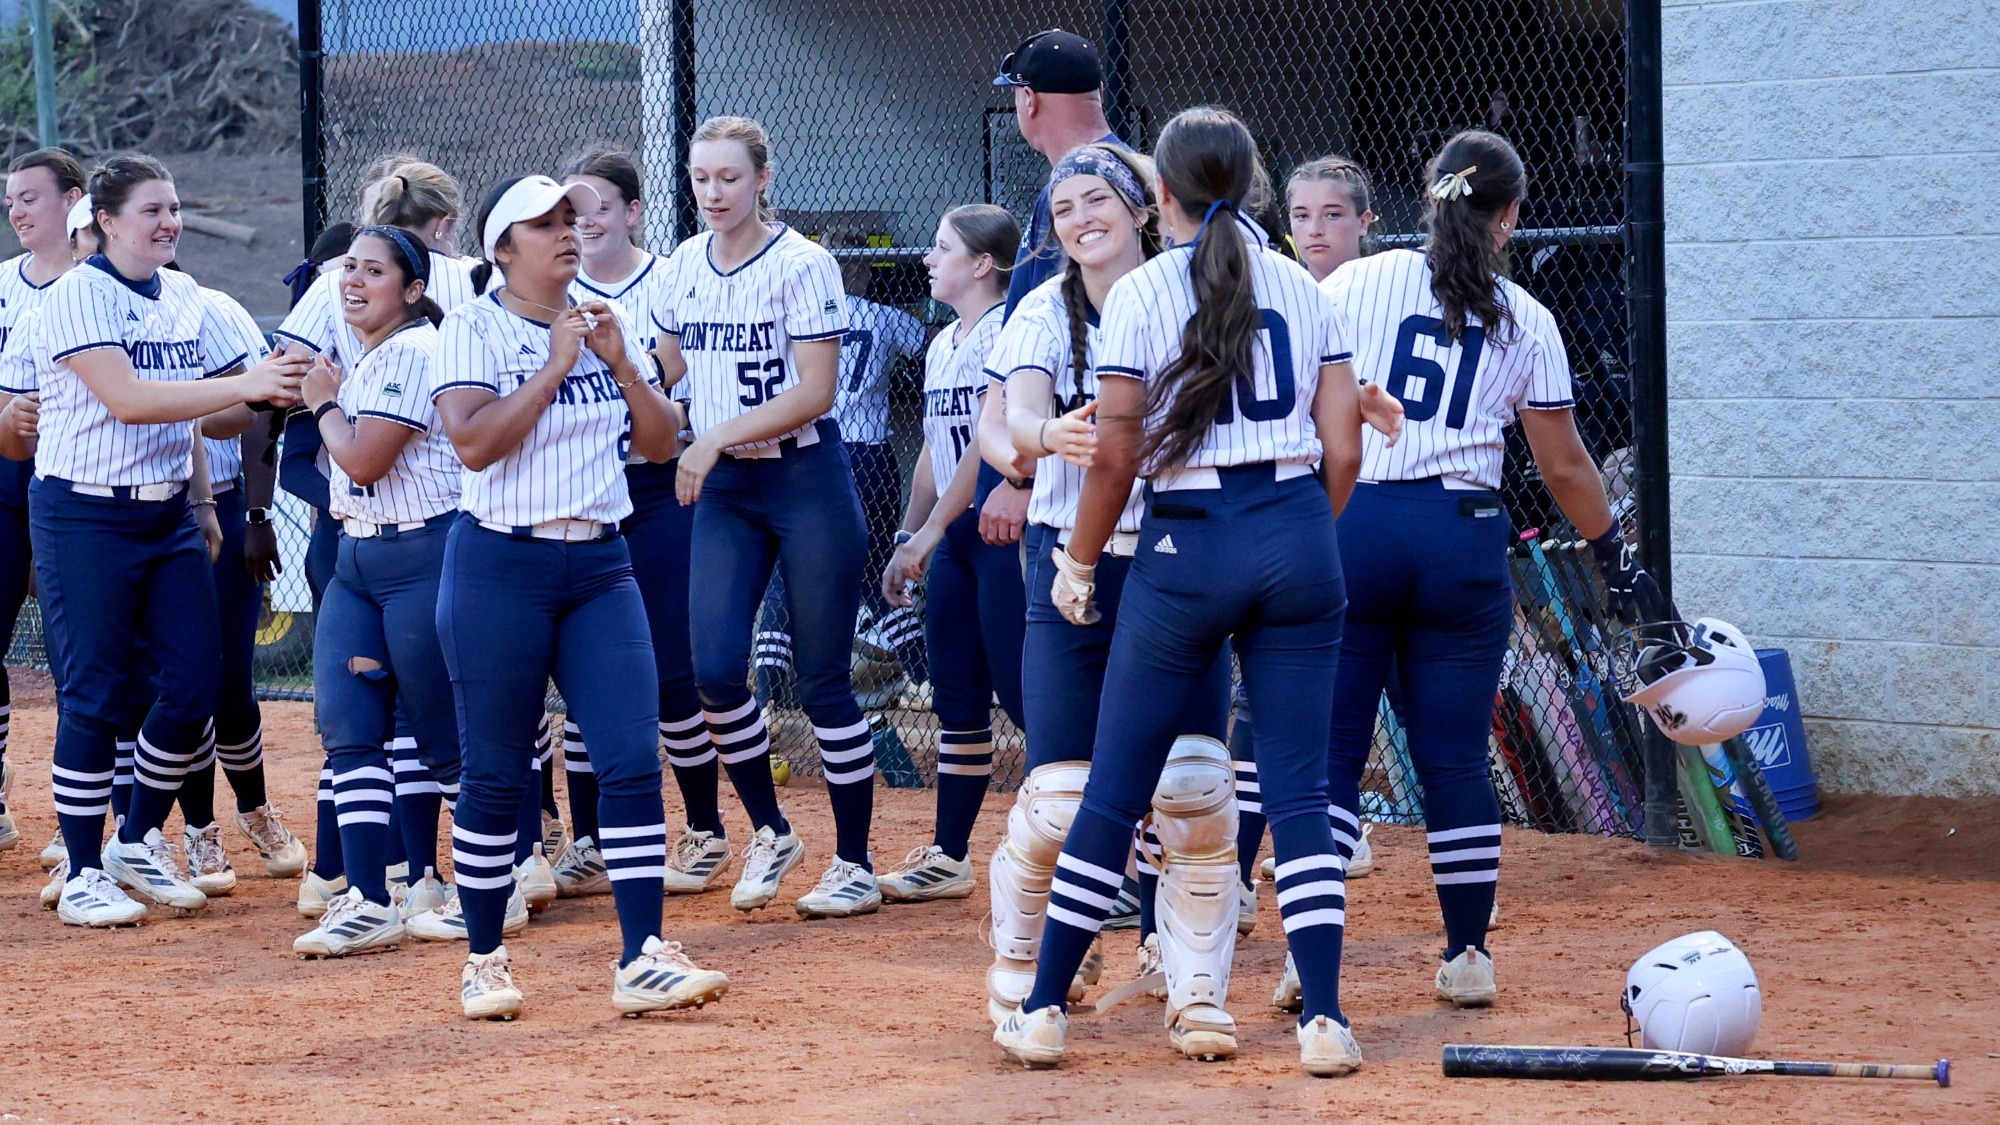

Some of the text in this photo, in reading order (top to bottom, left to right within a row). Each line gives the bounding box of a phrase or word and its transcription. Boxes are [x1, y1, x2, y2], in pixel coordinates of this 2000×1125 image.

[676, 320, 775, 352] MONTREAT
[121, 338, 203, 370] MONTRE
[387, 381, 402, 390] AAC
[737, 357, 786, 407] 52
[1385, 313, 1486, 430] 61
[923, 386, 974, 418] TREAT
